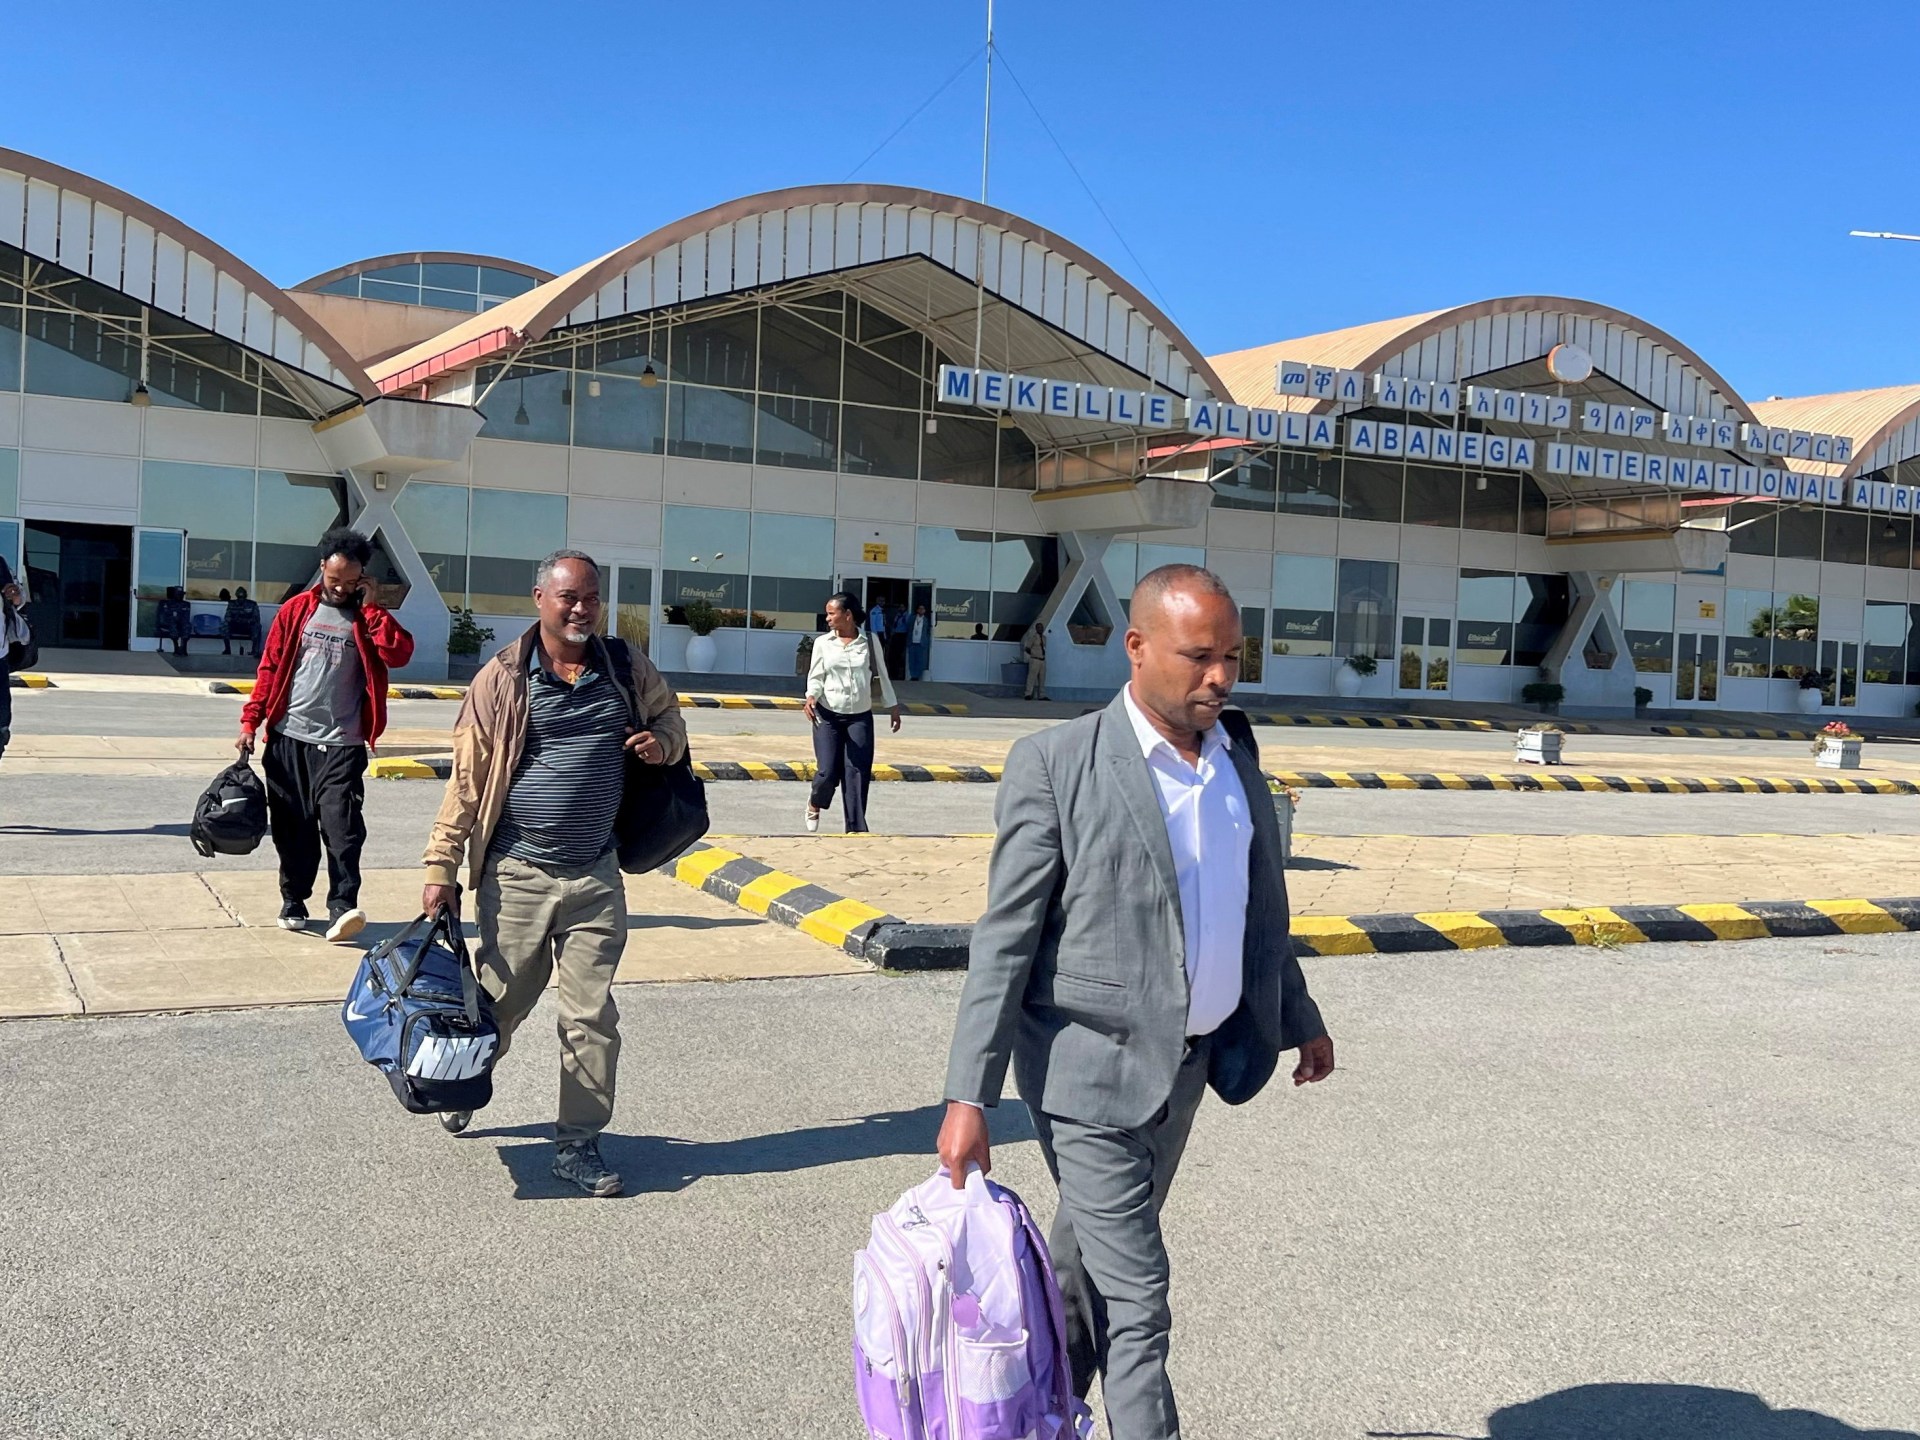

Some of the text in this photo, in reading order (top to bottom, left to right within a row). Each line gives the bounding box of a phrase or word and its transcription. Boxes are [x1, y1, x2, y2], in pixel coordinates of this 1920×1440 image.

[946, 370, 1167, 424] MEKELLE
[1193, 404, 1330, 443] ALULA
[1355, 425, 1530, 465] ABANEGA
[1555, 448, 1838, 501] INTERNATIONAL
[406, 1033, 497, 1080] NIKE
